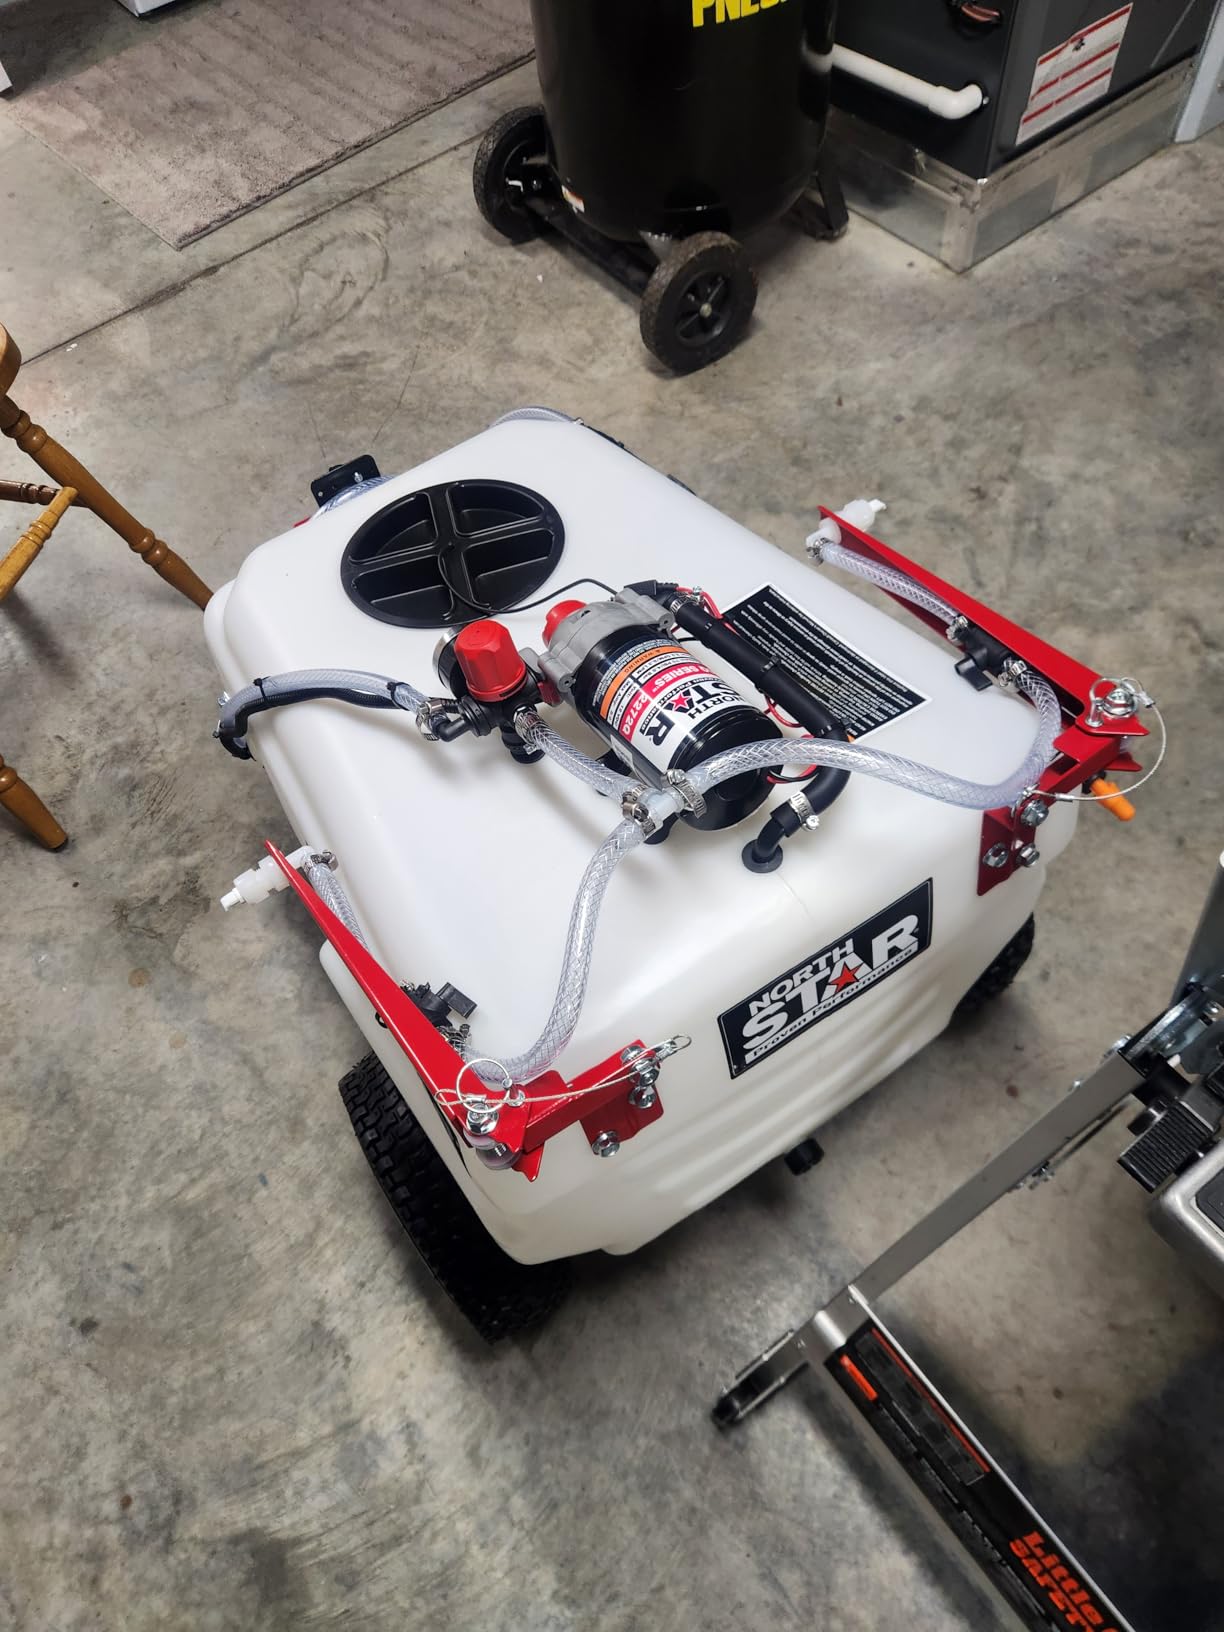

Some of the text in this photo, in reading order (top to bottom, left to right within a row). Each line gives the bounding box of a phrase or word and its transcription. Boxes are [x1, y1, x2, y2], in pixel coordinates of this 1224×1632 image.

[623, 651, 653, 674] WARNING
[742, 914, 919, 1050] STAR
[749, 938, 854, 1017] NORTH
[753, 949, 913, 1057] Proven Performance
[1022, 1531, 1104, 1625] Little
